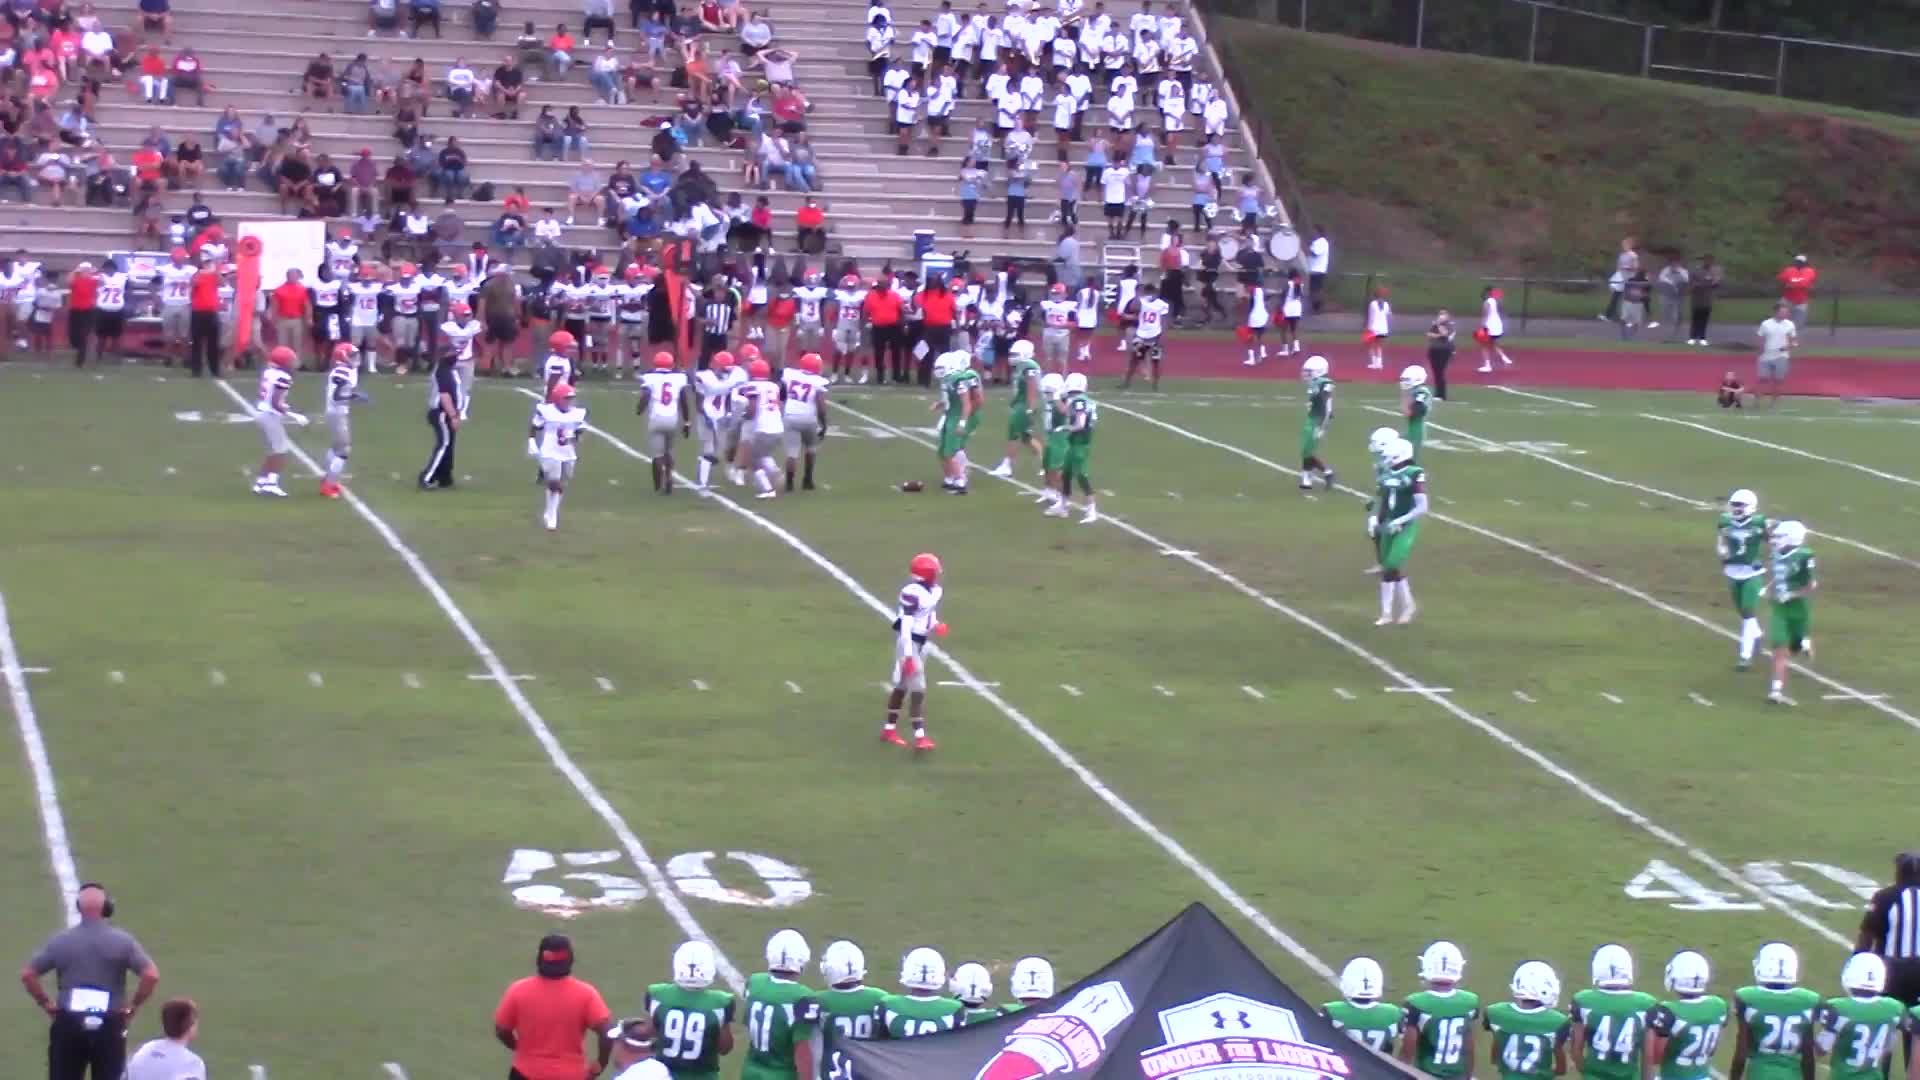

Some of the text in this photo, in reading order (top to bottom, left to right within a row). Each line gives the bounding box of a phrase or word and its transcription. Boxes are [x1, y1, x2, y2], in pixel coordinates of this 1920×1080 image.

[789, 380, 812, 403] 57
[503, 849, 813, 919] 50
[663, 1008, 706, 1060] 99
[1433, 1016, 1465, 1065] 16
[1592, 1015, 1636, 1064] 44
[1675, 1023, 1721, 1066] 20
[1758, 1014, 1803, 1055] 26
[1846, 1023, 1890, 1068] 34
[1140, 1041, 1223, 1077] UNDER
[1257, 1040, 1351, 1074] LIGHTS
